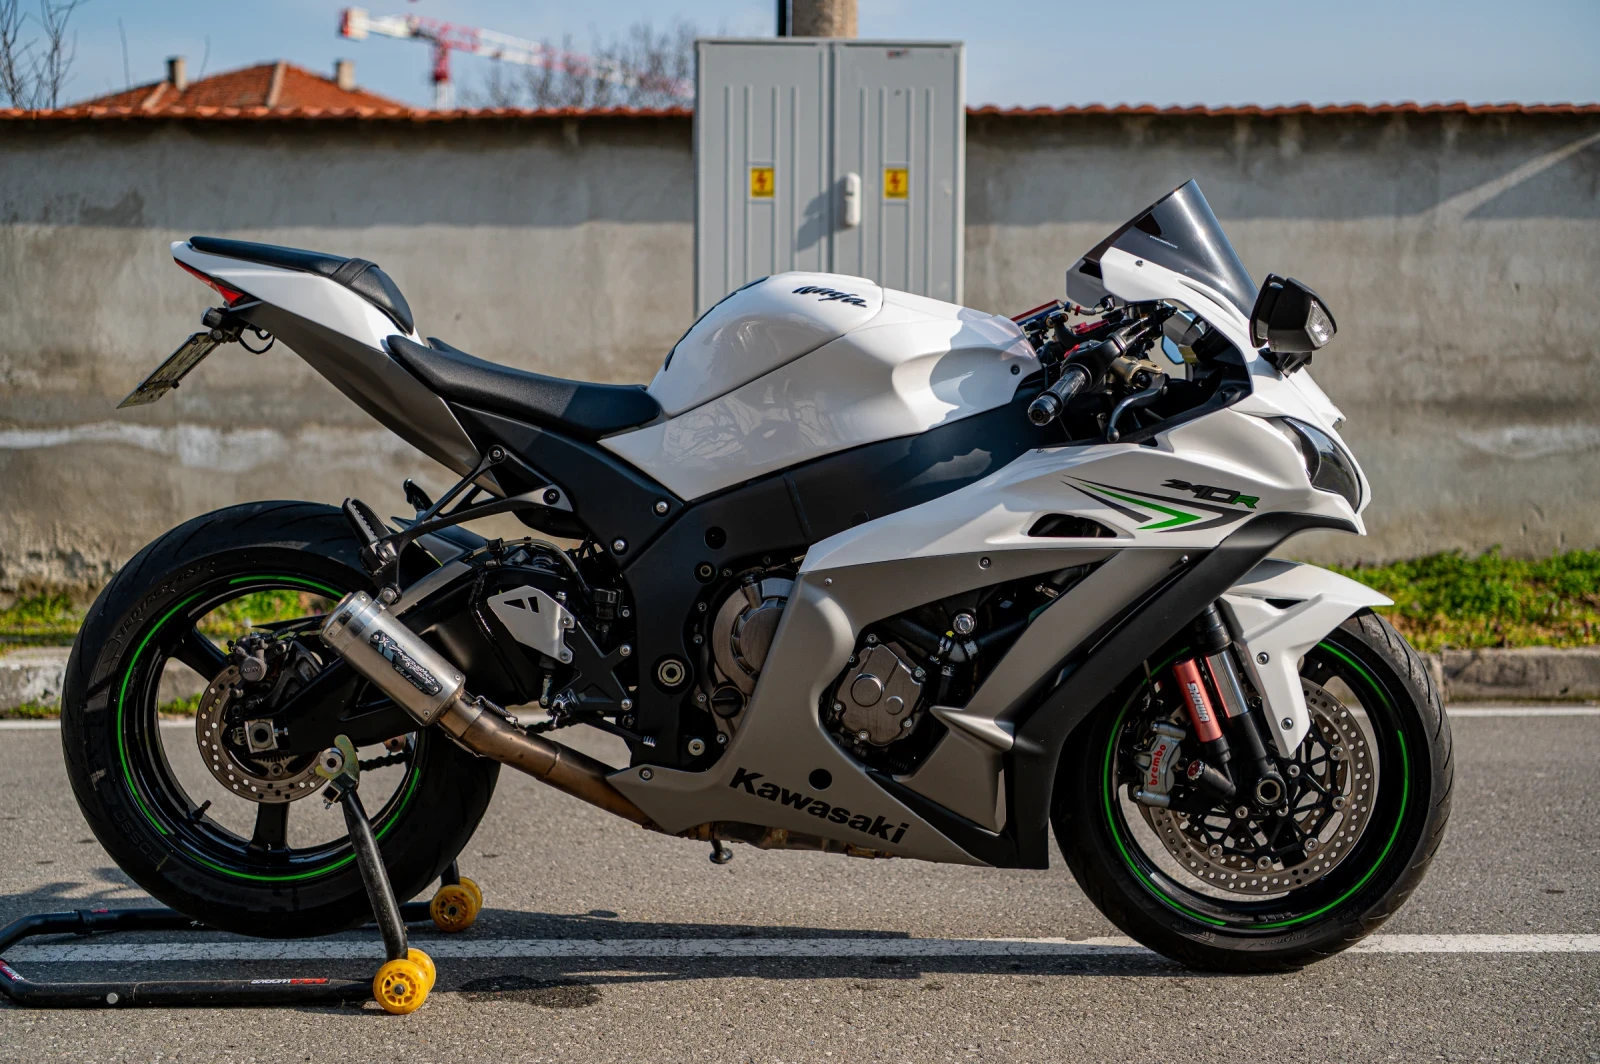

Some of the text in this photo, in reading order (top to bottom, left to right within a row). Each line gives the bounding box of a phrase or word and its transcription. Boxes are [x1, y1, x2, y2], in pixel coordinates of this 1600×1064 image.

[1187, 680, 1210, 724] SHOWA
[1149, 744, 1167, 786] brembo
[729, 767, 909, 844] Kawasaki
